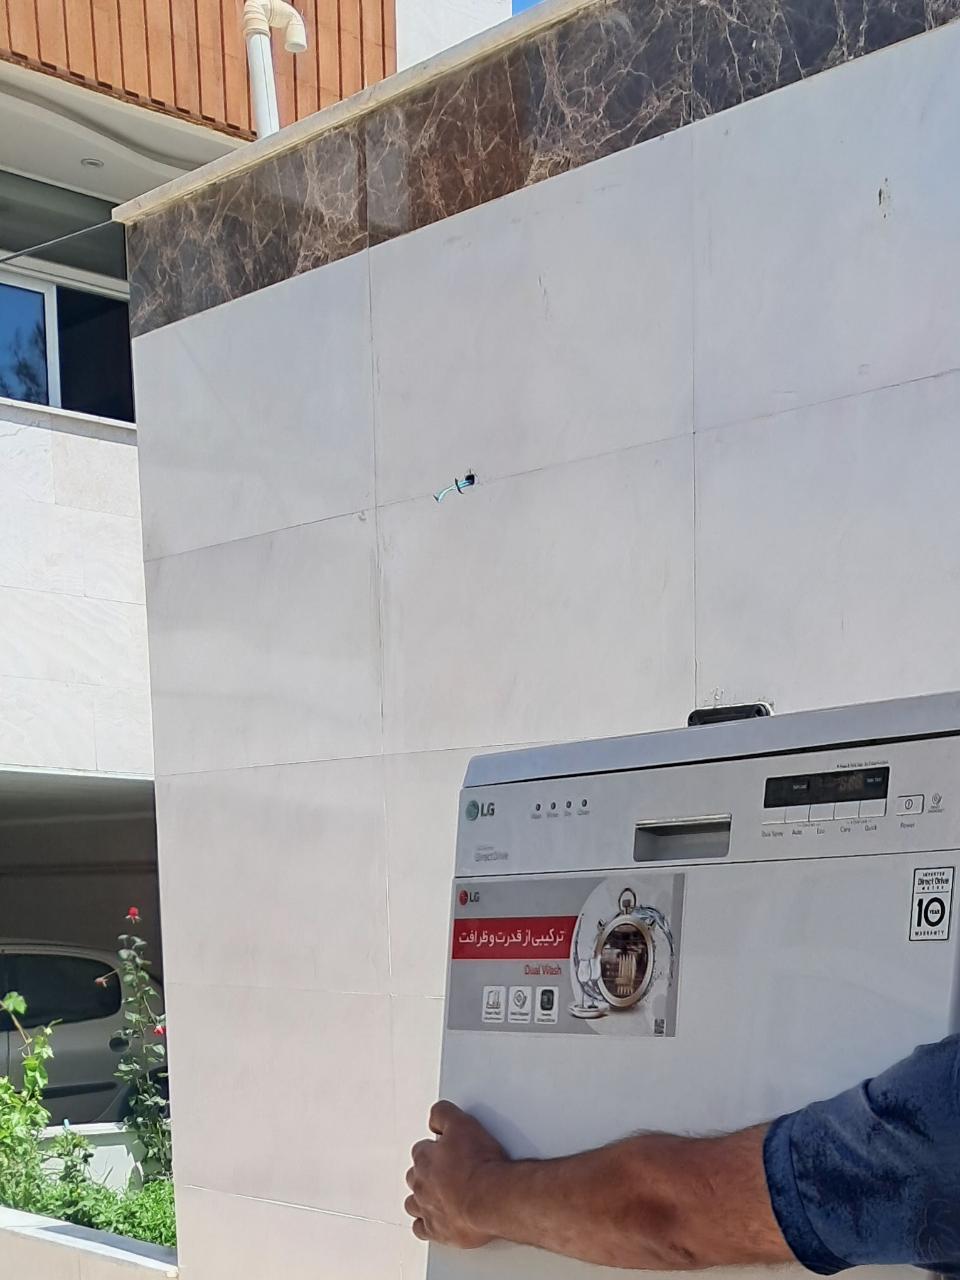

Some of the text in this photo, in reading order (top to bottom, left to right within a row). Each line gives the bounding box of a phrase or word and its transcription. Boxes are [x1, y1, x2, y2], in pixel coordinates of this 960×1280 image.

[481, 802, 495, 817] LG
[918, 877, 950, 886] Direct Drive
[469, 891, 480, 902] LG
[917, 897, 946, 927] 10
[458, 928, 566, 947] ترکیبی از قدرت و ظرافت
[524, 963, 562, 976] Dual Wash
